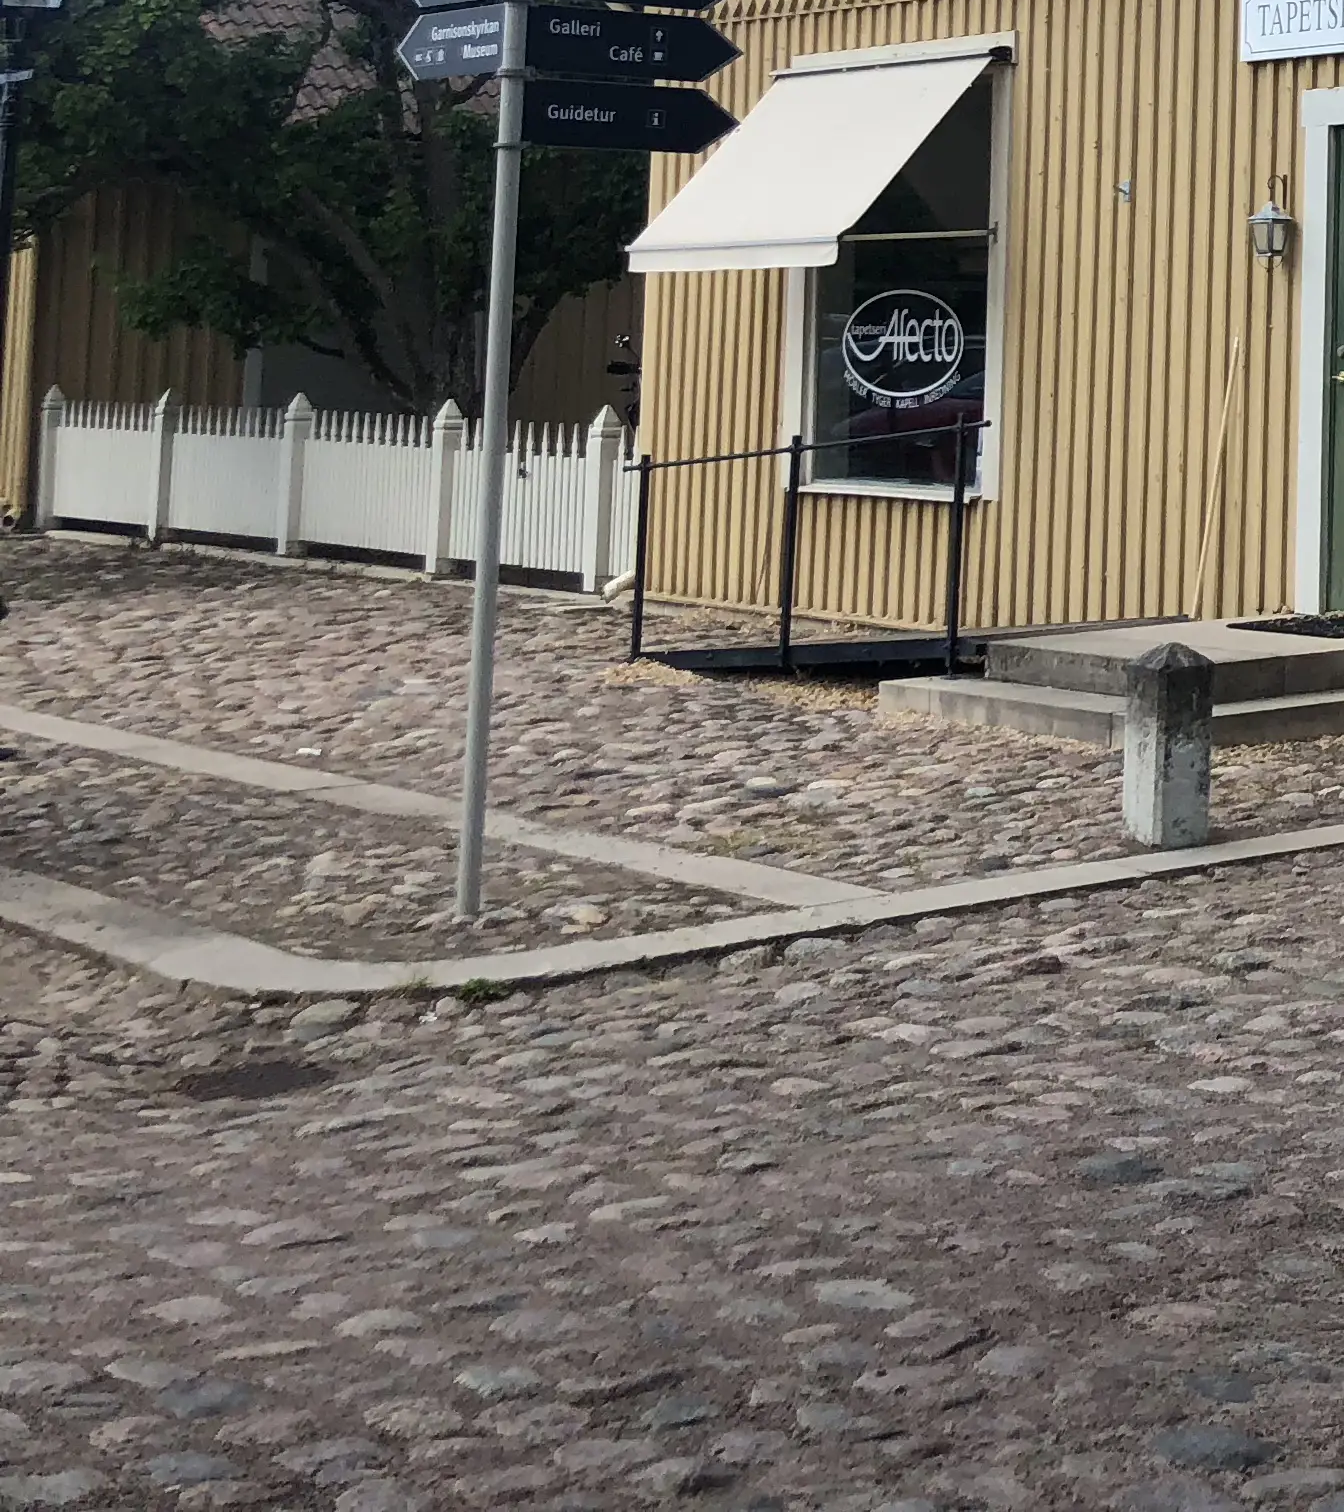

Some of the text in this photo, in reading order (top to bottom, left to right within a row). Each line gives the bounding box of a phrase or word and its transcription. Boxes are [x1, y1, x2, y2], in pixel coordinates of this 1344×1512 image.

[431, 19, 500, 41] Garnisonskyrkan
[550, 18, 601, 37] Galleri
[462, 44, 499, 60] Museum
[609, 45, 644, 62] Café
[547, 104, 617, 123] Guidetur
[871, 392, 892, 408] TYGER
[895, 397, 920, 409] KAPELL
